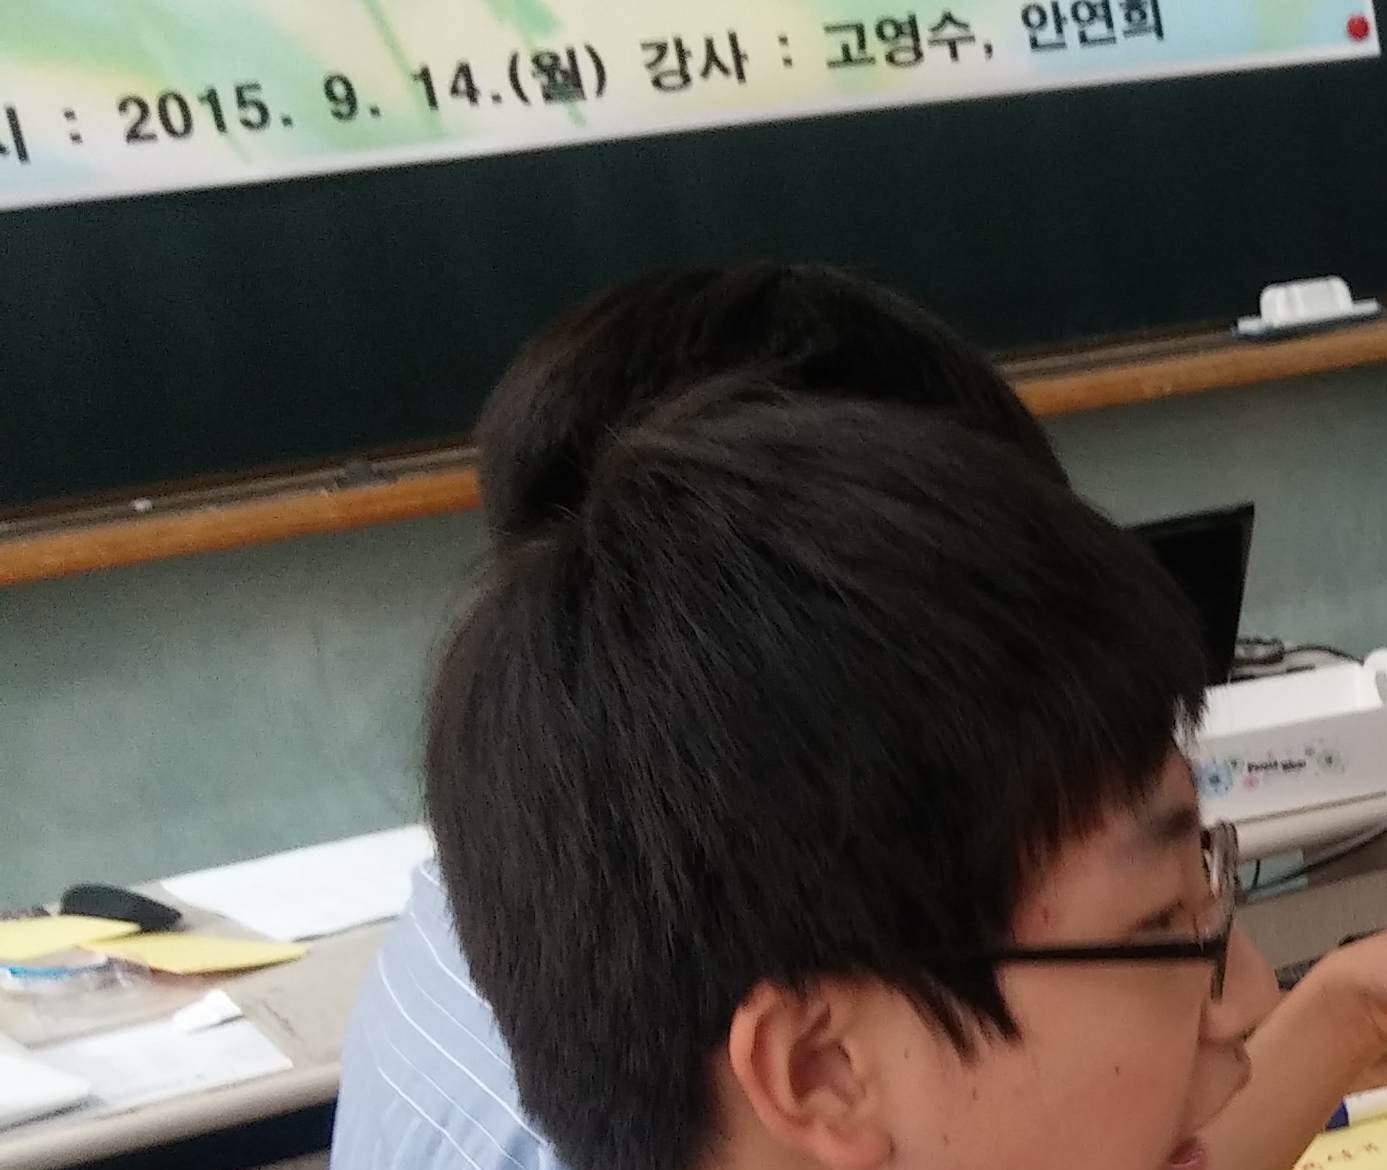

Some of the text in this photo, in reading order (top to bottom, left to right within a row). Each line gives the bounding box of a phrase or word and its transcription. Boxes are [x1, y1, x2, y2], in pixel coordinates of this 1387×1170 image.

[118, 81, 294, 145] 2015.
[323, 71, 382, 122] 9.
[410, 43, 607, 112] 14.(월)
[640, 30, 749, 93] 강사
[823, 10, 993, 69] 고영수,
[1021, 0, 1164, 54] 안연희
